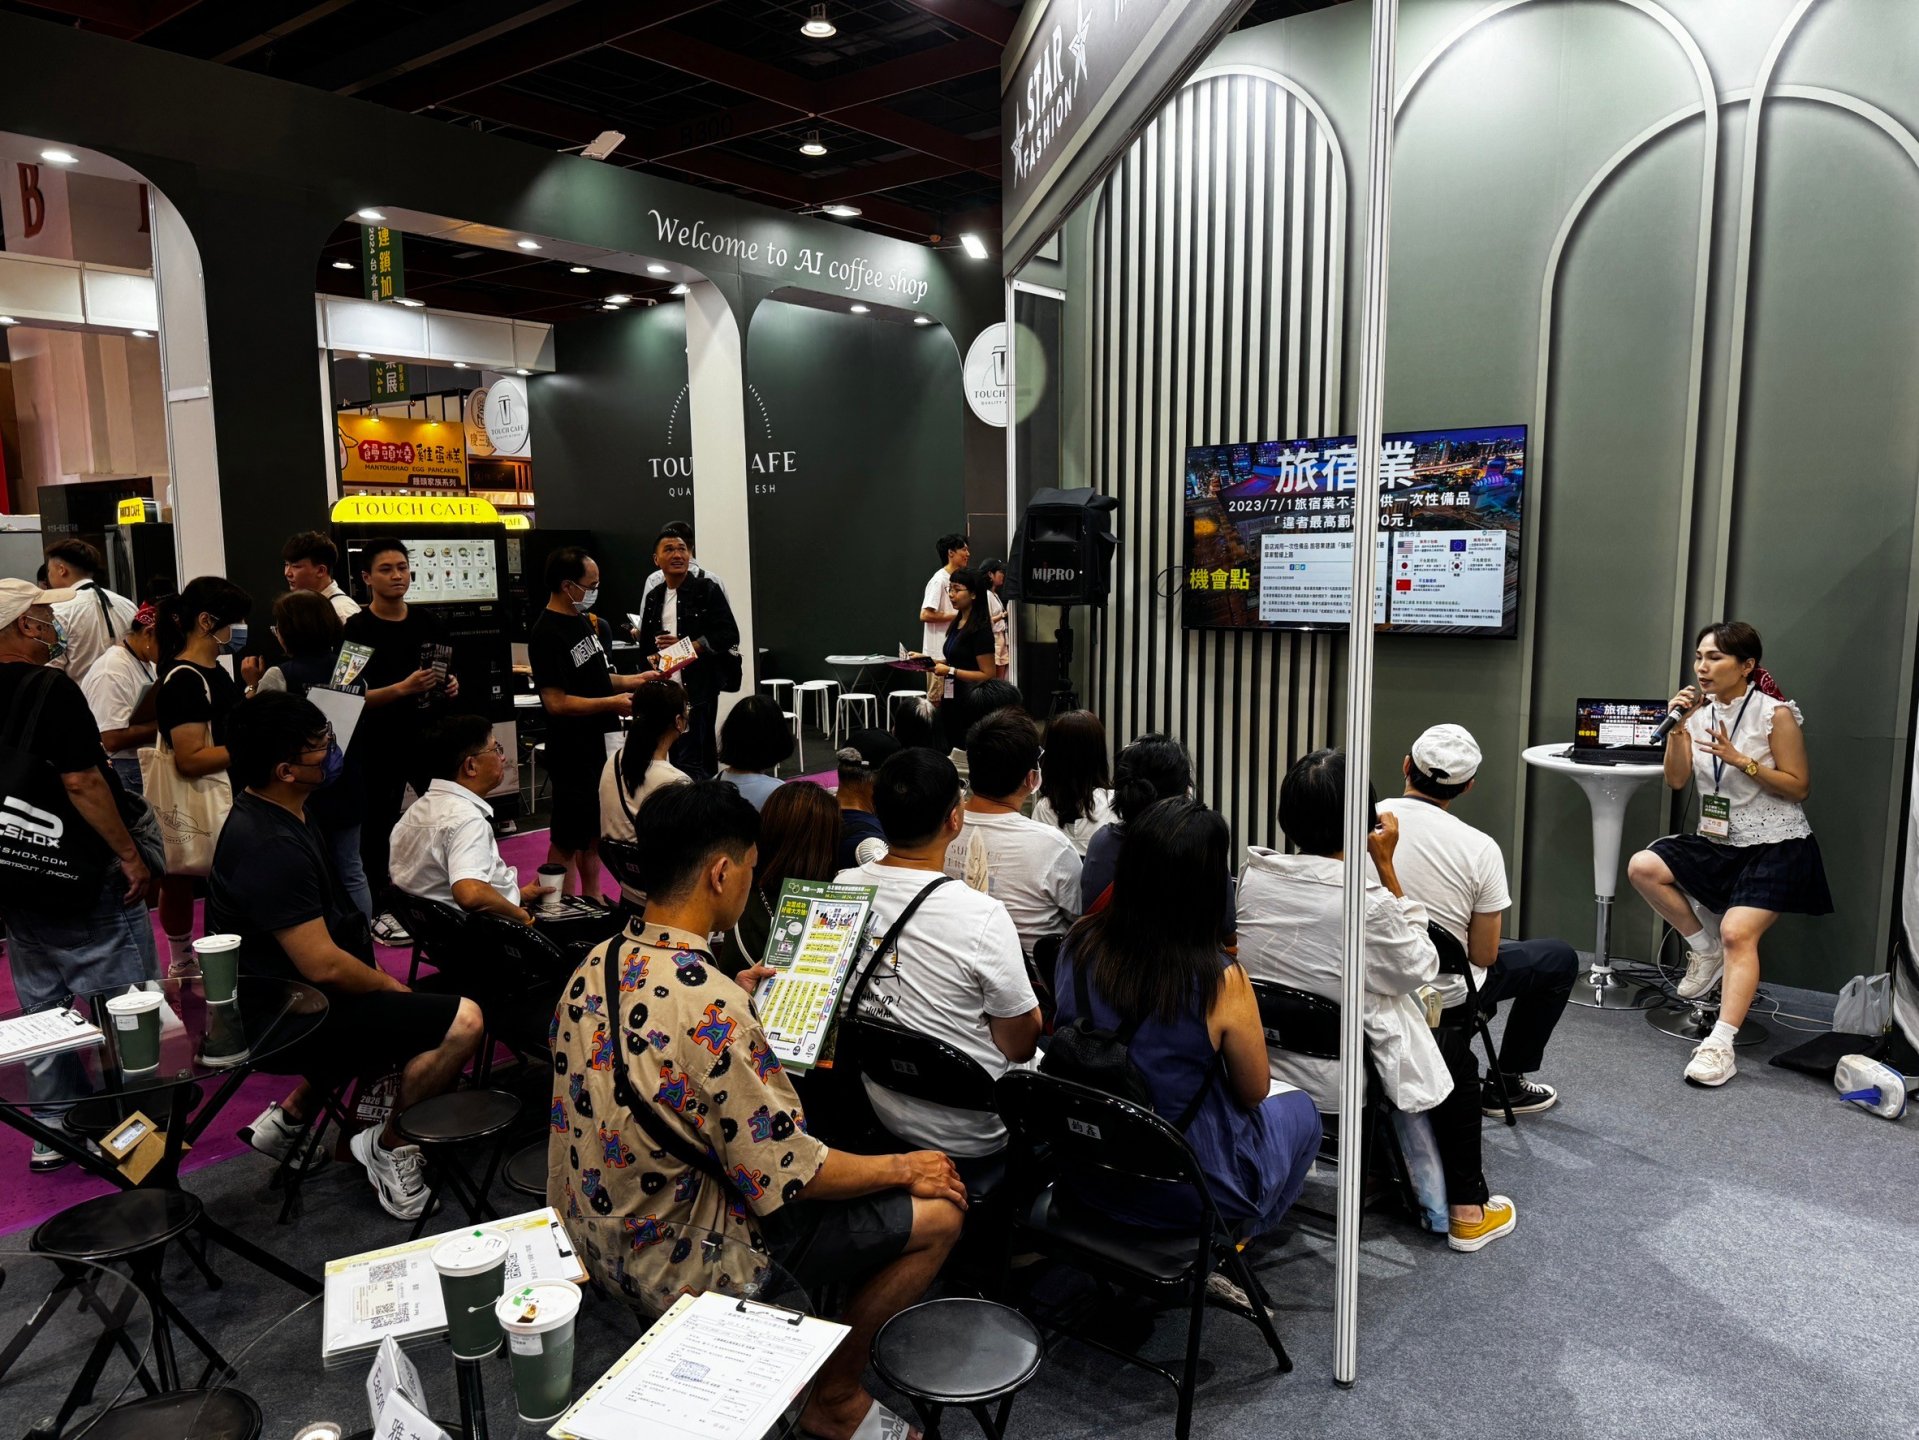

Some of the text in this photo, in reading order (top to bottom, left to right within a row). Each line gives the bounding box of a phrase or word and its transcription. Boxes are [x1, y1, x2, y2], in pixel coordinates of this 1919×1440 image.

[1026, 24, 1065, 132] STAR
[1023, 78, 1072, 180] FASHION
[17, 162, 45, 239] B
[647, 208, 928, 303] Welcome to AI coffee shop
[974, 390, 1006, 399] TOUCH
[364, 464, 409, 472] MANTOUSHAO
[427, 466, 460, 474] PANCAKES
[648, 450, 797, 478] TOU AFE
[755, 484, 777, 495] ESH
[350, 501, 481, 516] TOUCH CAFE
[1189, 567, 1251, 591] 機會點
[881, 995, 894, 1006] UP
